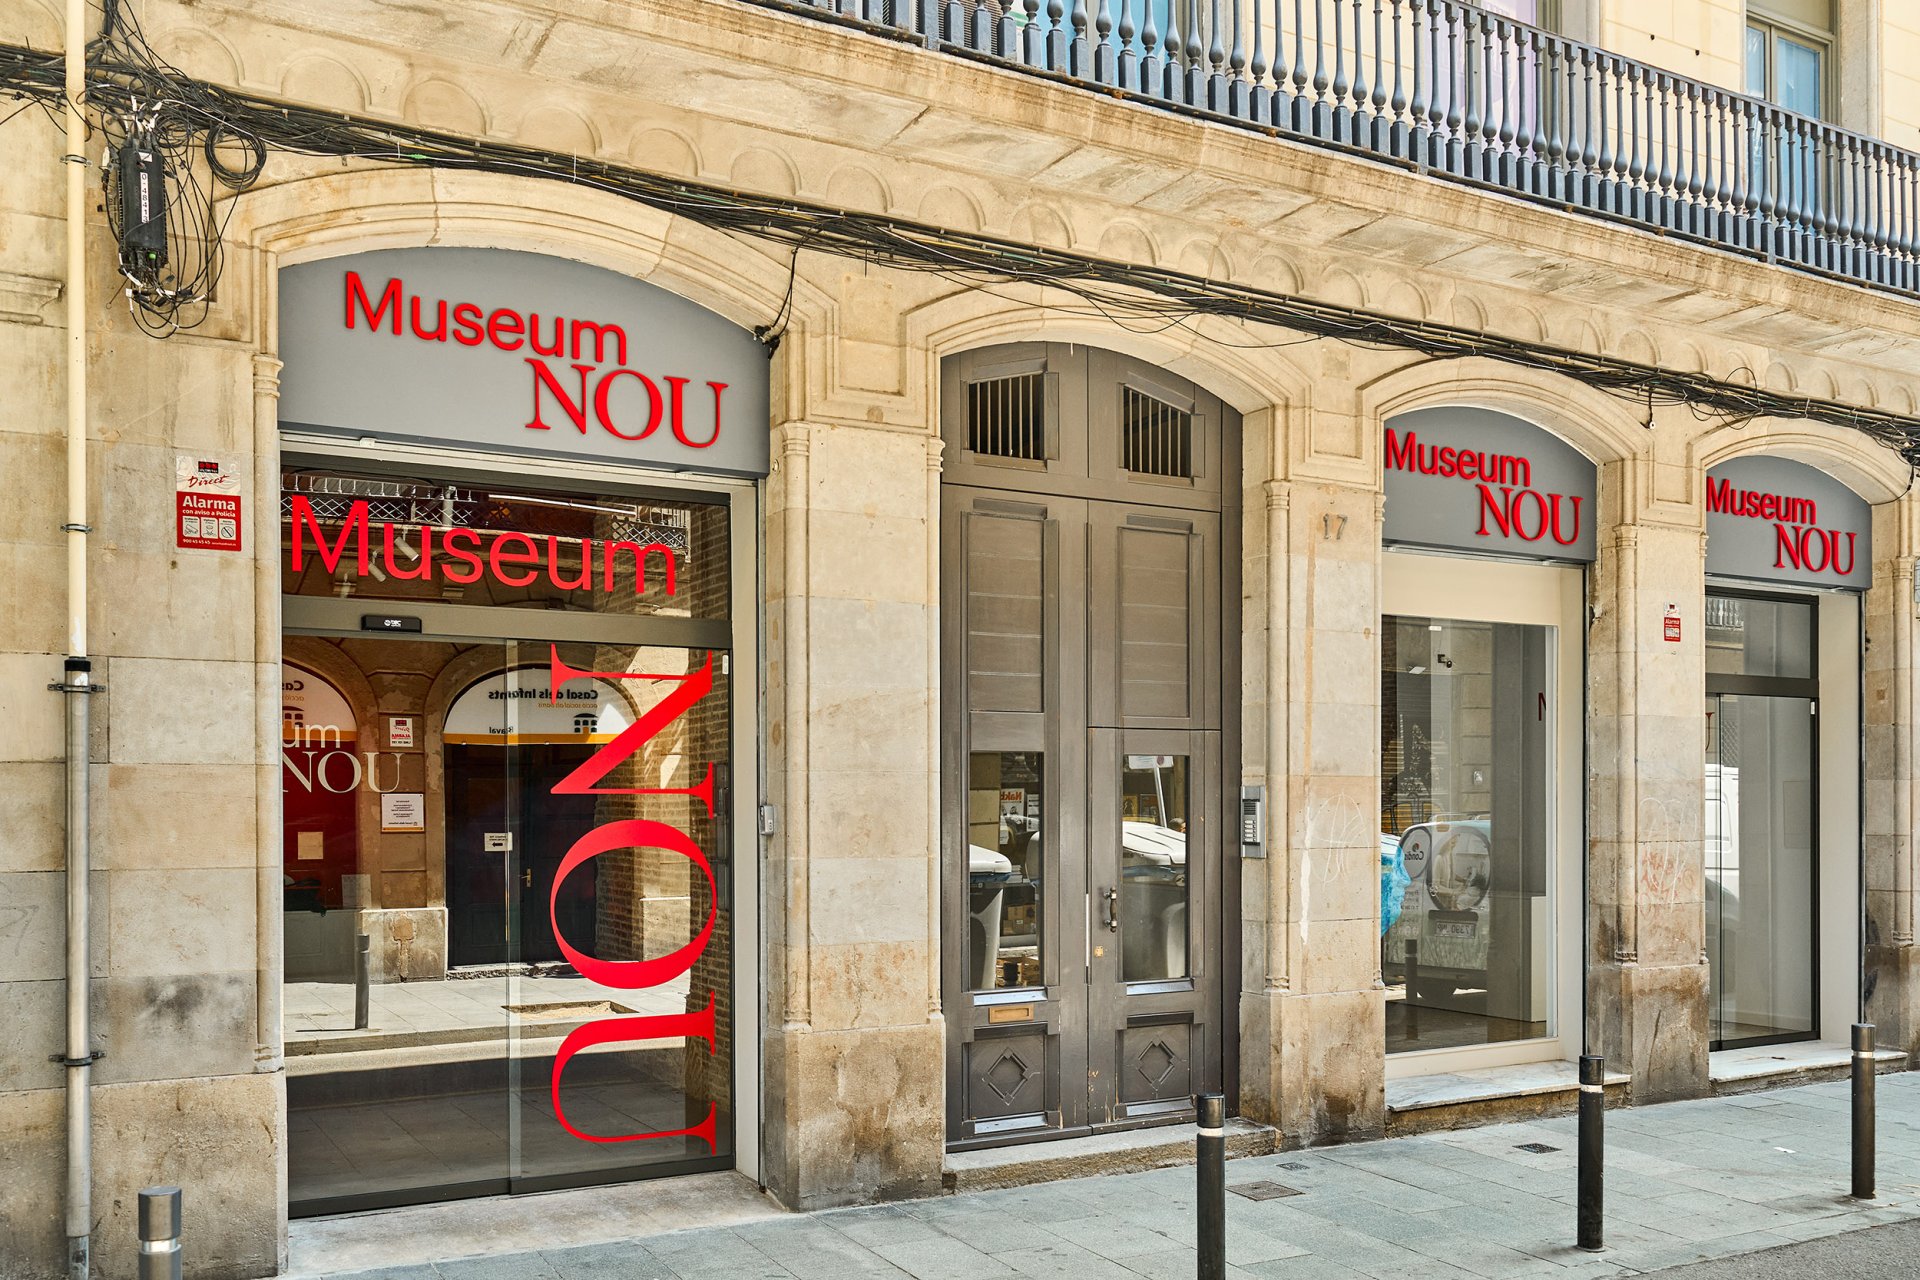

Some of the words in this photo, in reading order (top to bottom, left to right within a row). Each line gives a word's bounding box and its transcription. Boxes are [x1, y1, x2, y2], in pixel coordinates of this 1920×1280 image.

[345, 271, 627, 367] Museum
[525, 357, 730, 449] NOU
[1386, 428, 1531, 487] Museum
[183, 496, 235, 510] Alarma
[1322, 513, 1349, 541] 17
[1476, 482, 1584, 545] NOU
[1706, 476, 1817, 526] Museum
[290, 493, 677, 598] Museum
[1774, 522, 1858, 577] NOU
[282, 750, 406, 793] NOU
[550, 643, 718, 1155] NOU
